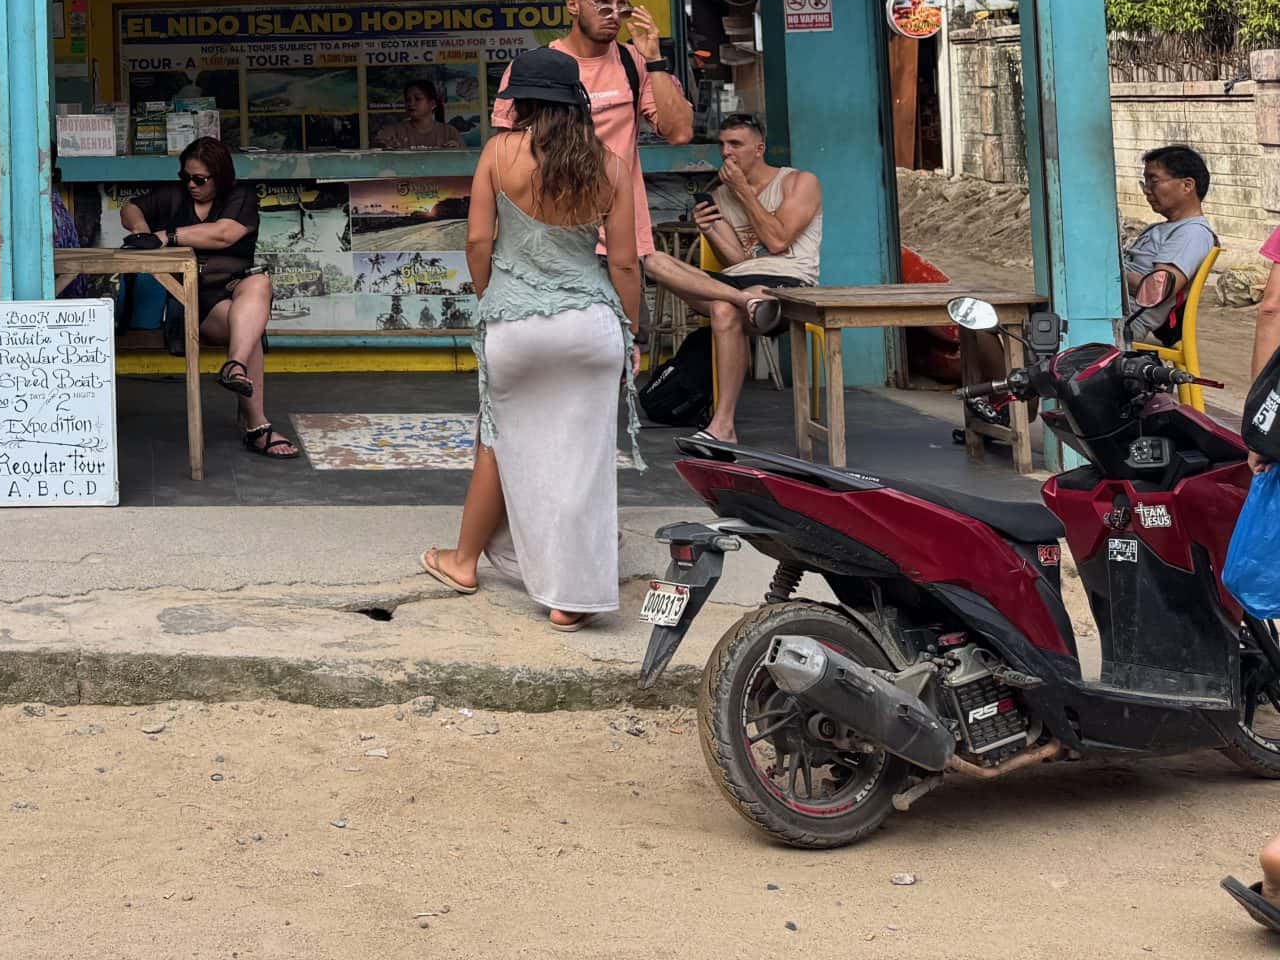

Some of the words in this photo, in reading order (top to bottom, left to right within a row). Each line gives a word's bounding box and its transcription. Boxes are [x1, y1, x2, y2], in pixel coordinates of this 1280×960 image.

[126, 16, 160, 39] EL
[161, 13, 240, 37] NIDO
[246, 10, 354, 35] ISLAND
[360, 6, 495, 32] HOPPING
[787, 15, 799, 24] NO
[800, 13, 830, 24] VAPING
[248, 44, 276, 52] TOURS
[278, 43, 317, 52] SUBJECT
[319, 42, 332, 50] TO
[381, 41, 400, 49] ECO
[402, 40, 419, 48] TAX
[421, 40, 438, 48] FEE
[439, 39, 466, 47] VALID
[467, 38, 486, 46] FOR
[499, 37, 524, 46] DAYS
[246, 54, 290, 67] TOUR
[303, 54, 314, 65] B
[366, 51, 410, 64] TOUR
[423, 51, 434, 62] C
[486, 48, 529, 60] TOU
[128, 58, 172, 70] TOUR
[185, 56, 196, 69] A
[57, 118, 112, 132] MOTORBIKE
[80, 136, 112, 150] RENTAL
[256, 183, 267, 198] 3
[6, 311, 49, 326] BOOK
[60, 330, 96, 346] Tour
[57, 344, 107, 364] Boat
[53, 368, 104, 389] Boat
[56, 393, 72, 412] 2
[4, 415, 93, 437] Expedition
[66, 448, 106, 474] Tour
[86, 480, 97, 496] D
[1145, 515, 1172, 527] JESUS
